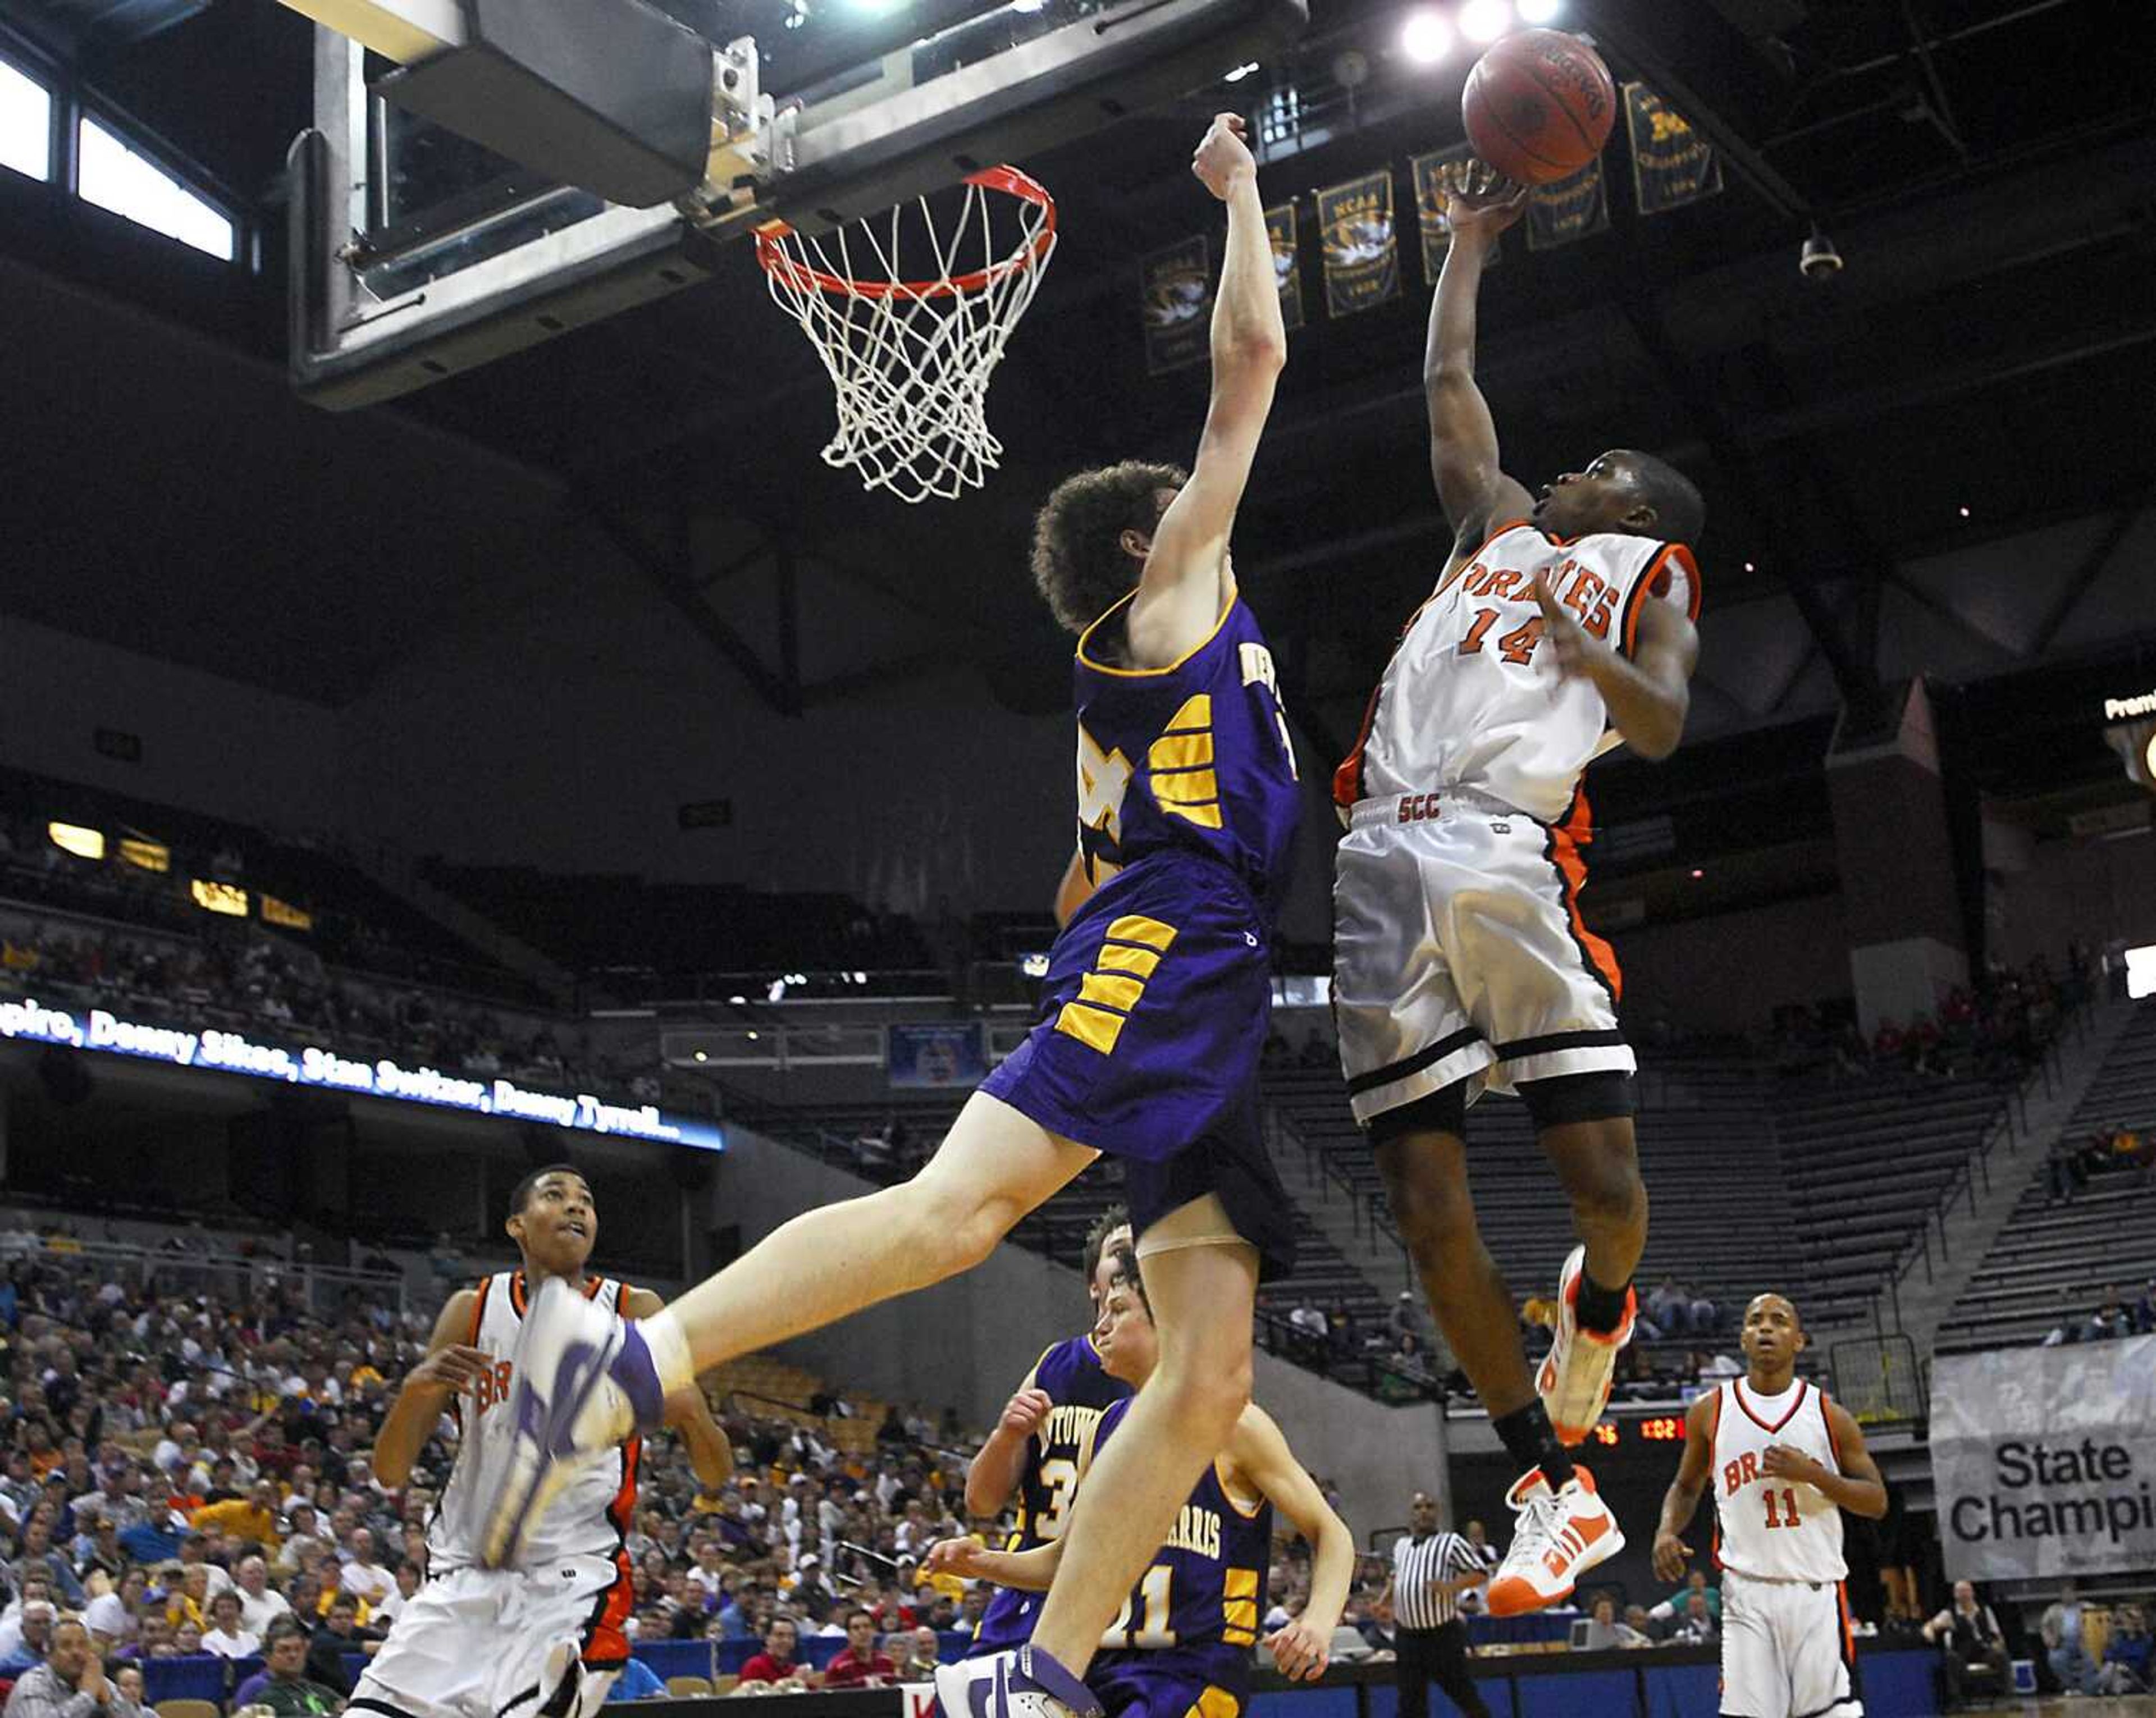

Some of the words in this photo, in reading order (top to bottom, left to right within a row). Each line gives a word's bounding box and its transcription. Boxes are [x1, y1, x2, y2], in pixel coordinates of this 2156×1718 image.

[1459, 608, 1544, 665] 14
[1997, 1437, 2131, 1488] State
[1162, 1504, 1222, 1560] ARRIS
[1762, 1488, 1801, 1529] 11
